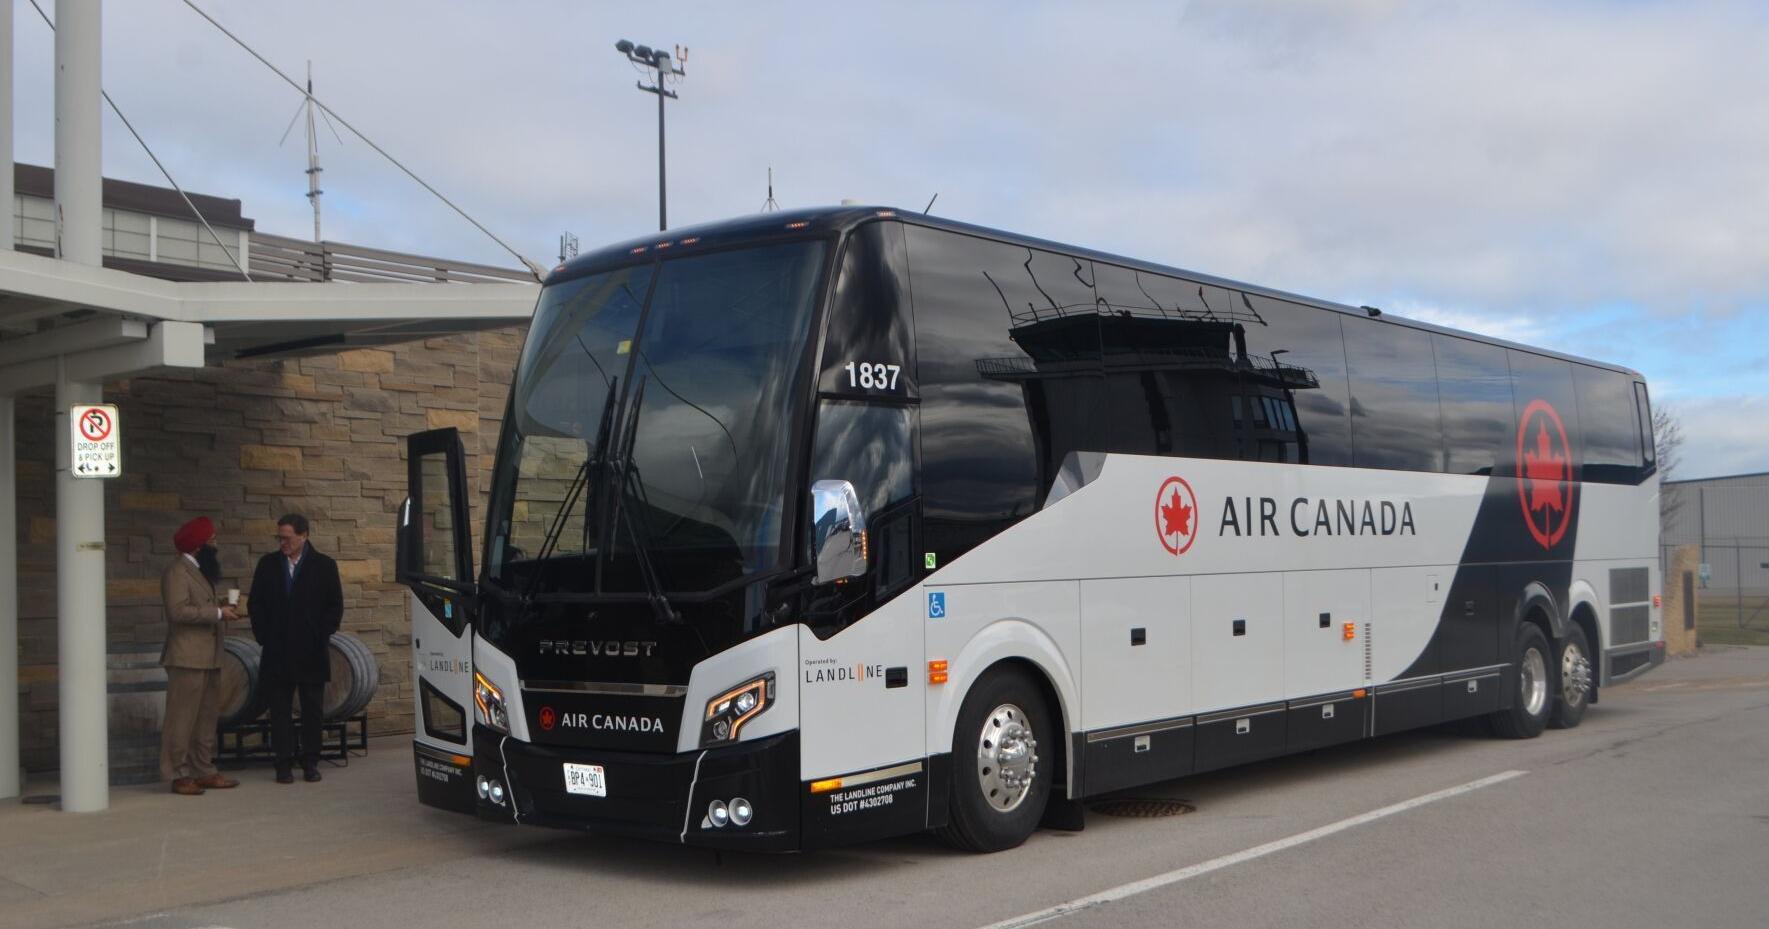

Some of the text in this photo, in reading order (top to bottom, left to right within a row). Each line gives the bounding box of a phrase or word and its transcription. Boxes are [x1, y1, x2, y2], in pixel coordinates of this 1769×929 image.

[845, 361, 900, 390] 1837
[77, 442, 114, 450] DROP OFF
[85, 453, 102, 461] PICK
[105, 453, 114, 461] UP
[1219, 496, 1416, 537] AIR CANADA
[539, 640, 657, 656] PREVOST
[561, 713, 664, 733] AIR CANADA
[830, 779, 916, 803] THE LANDLINE COMPANY INC.
[830, 793, 894, 815] US DOT #4302708
